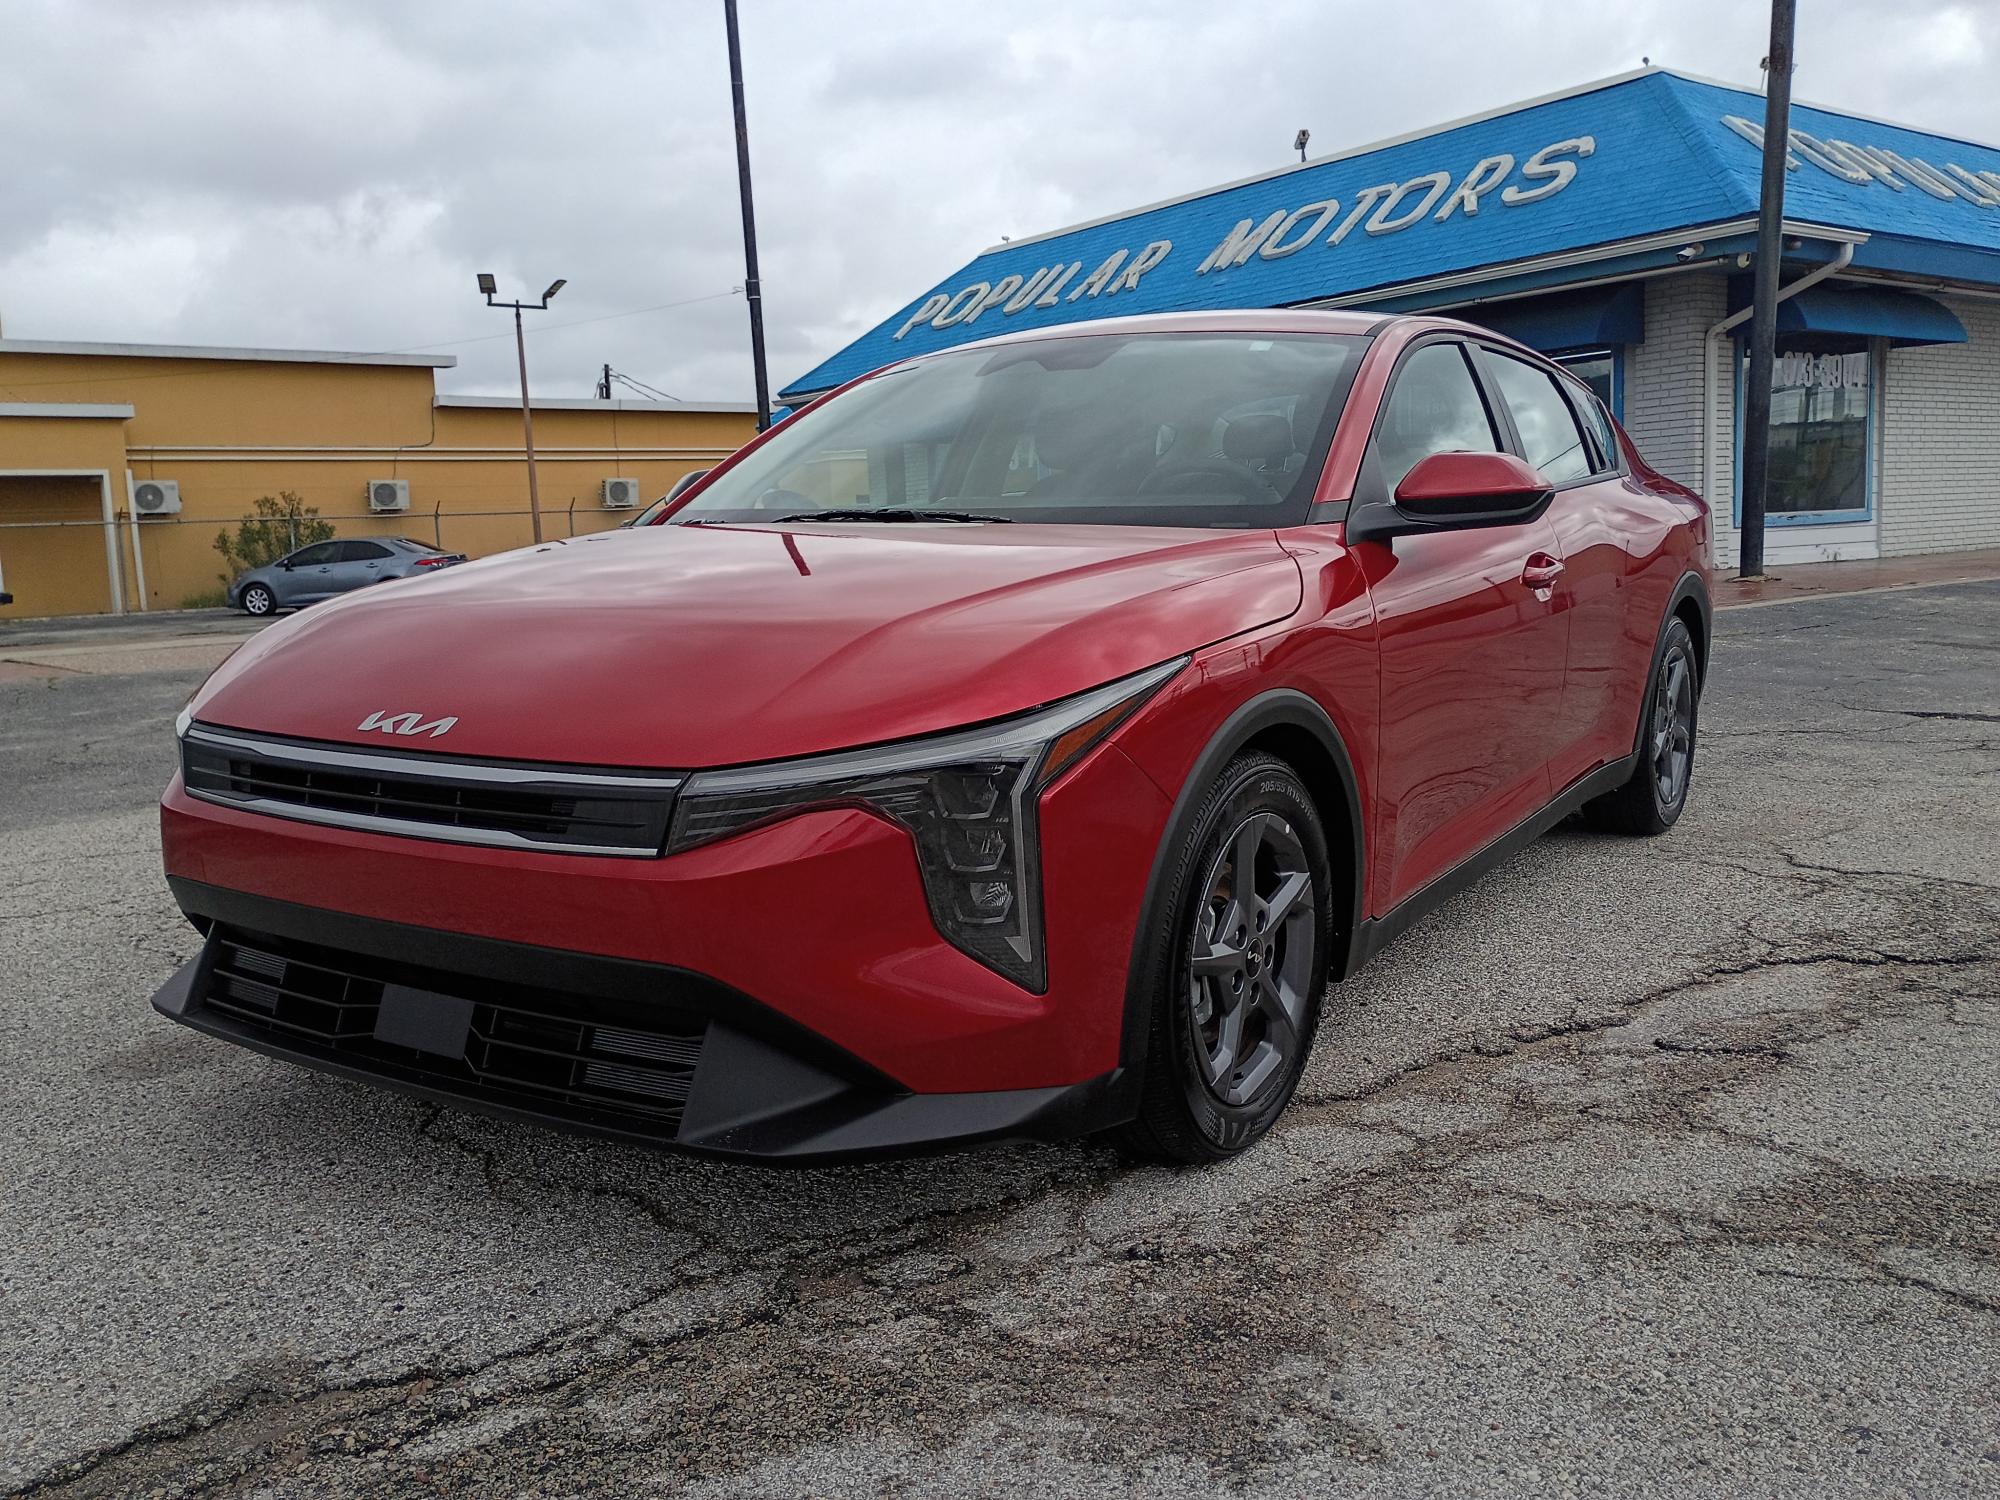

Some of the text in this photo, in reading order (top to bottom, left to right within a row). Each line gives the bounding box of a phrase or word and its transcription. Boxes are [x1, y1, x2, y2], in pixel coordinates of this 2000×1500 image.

[892, 135, 1597, 340] POPULAR MOTORS
[357, 709, 459, 738] KIA
